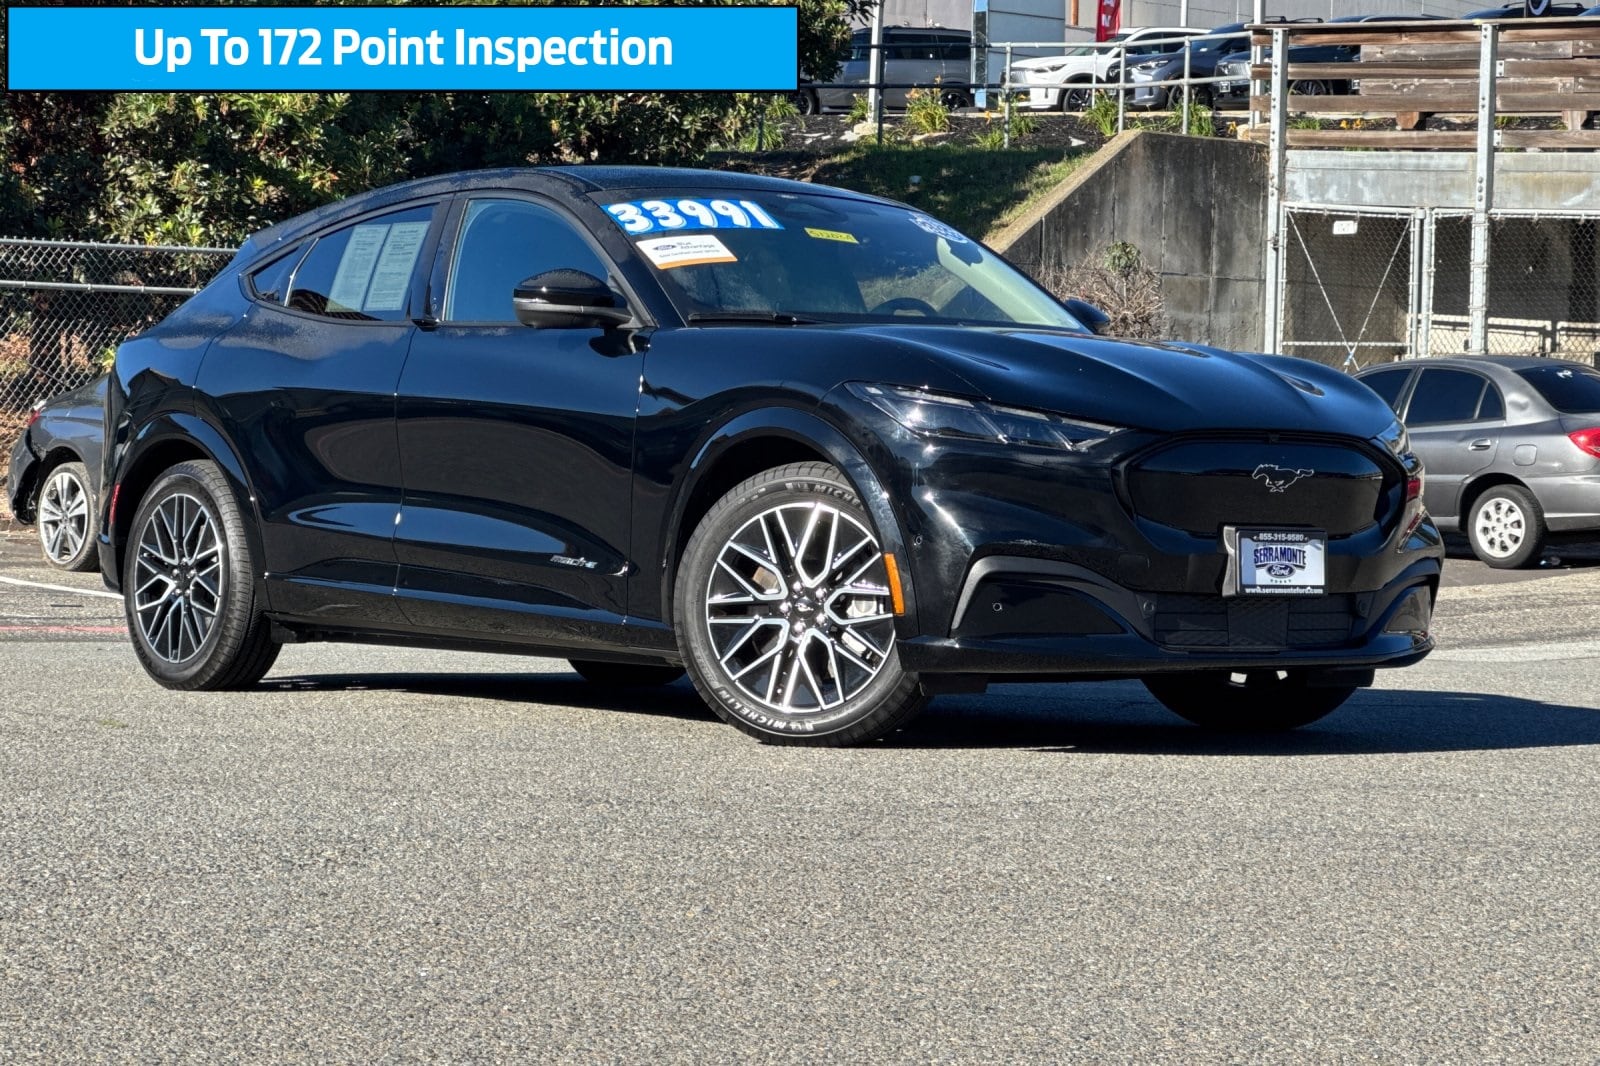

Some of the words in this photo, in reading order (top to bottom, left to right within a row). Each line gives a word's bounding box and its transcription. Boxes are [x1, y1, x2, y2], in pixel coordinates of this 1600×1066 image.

[607, 199, 779, 233] 33991
[1254, 547, 1306, 565] SERRAMONTE
[1270, 565, 1290, 575] Ford
[718, 689, 787, 730] MICHELIN
